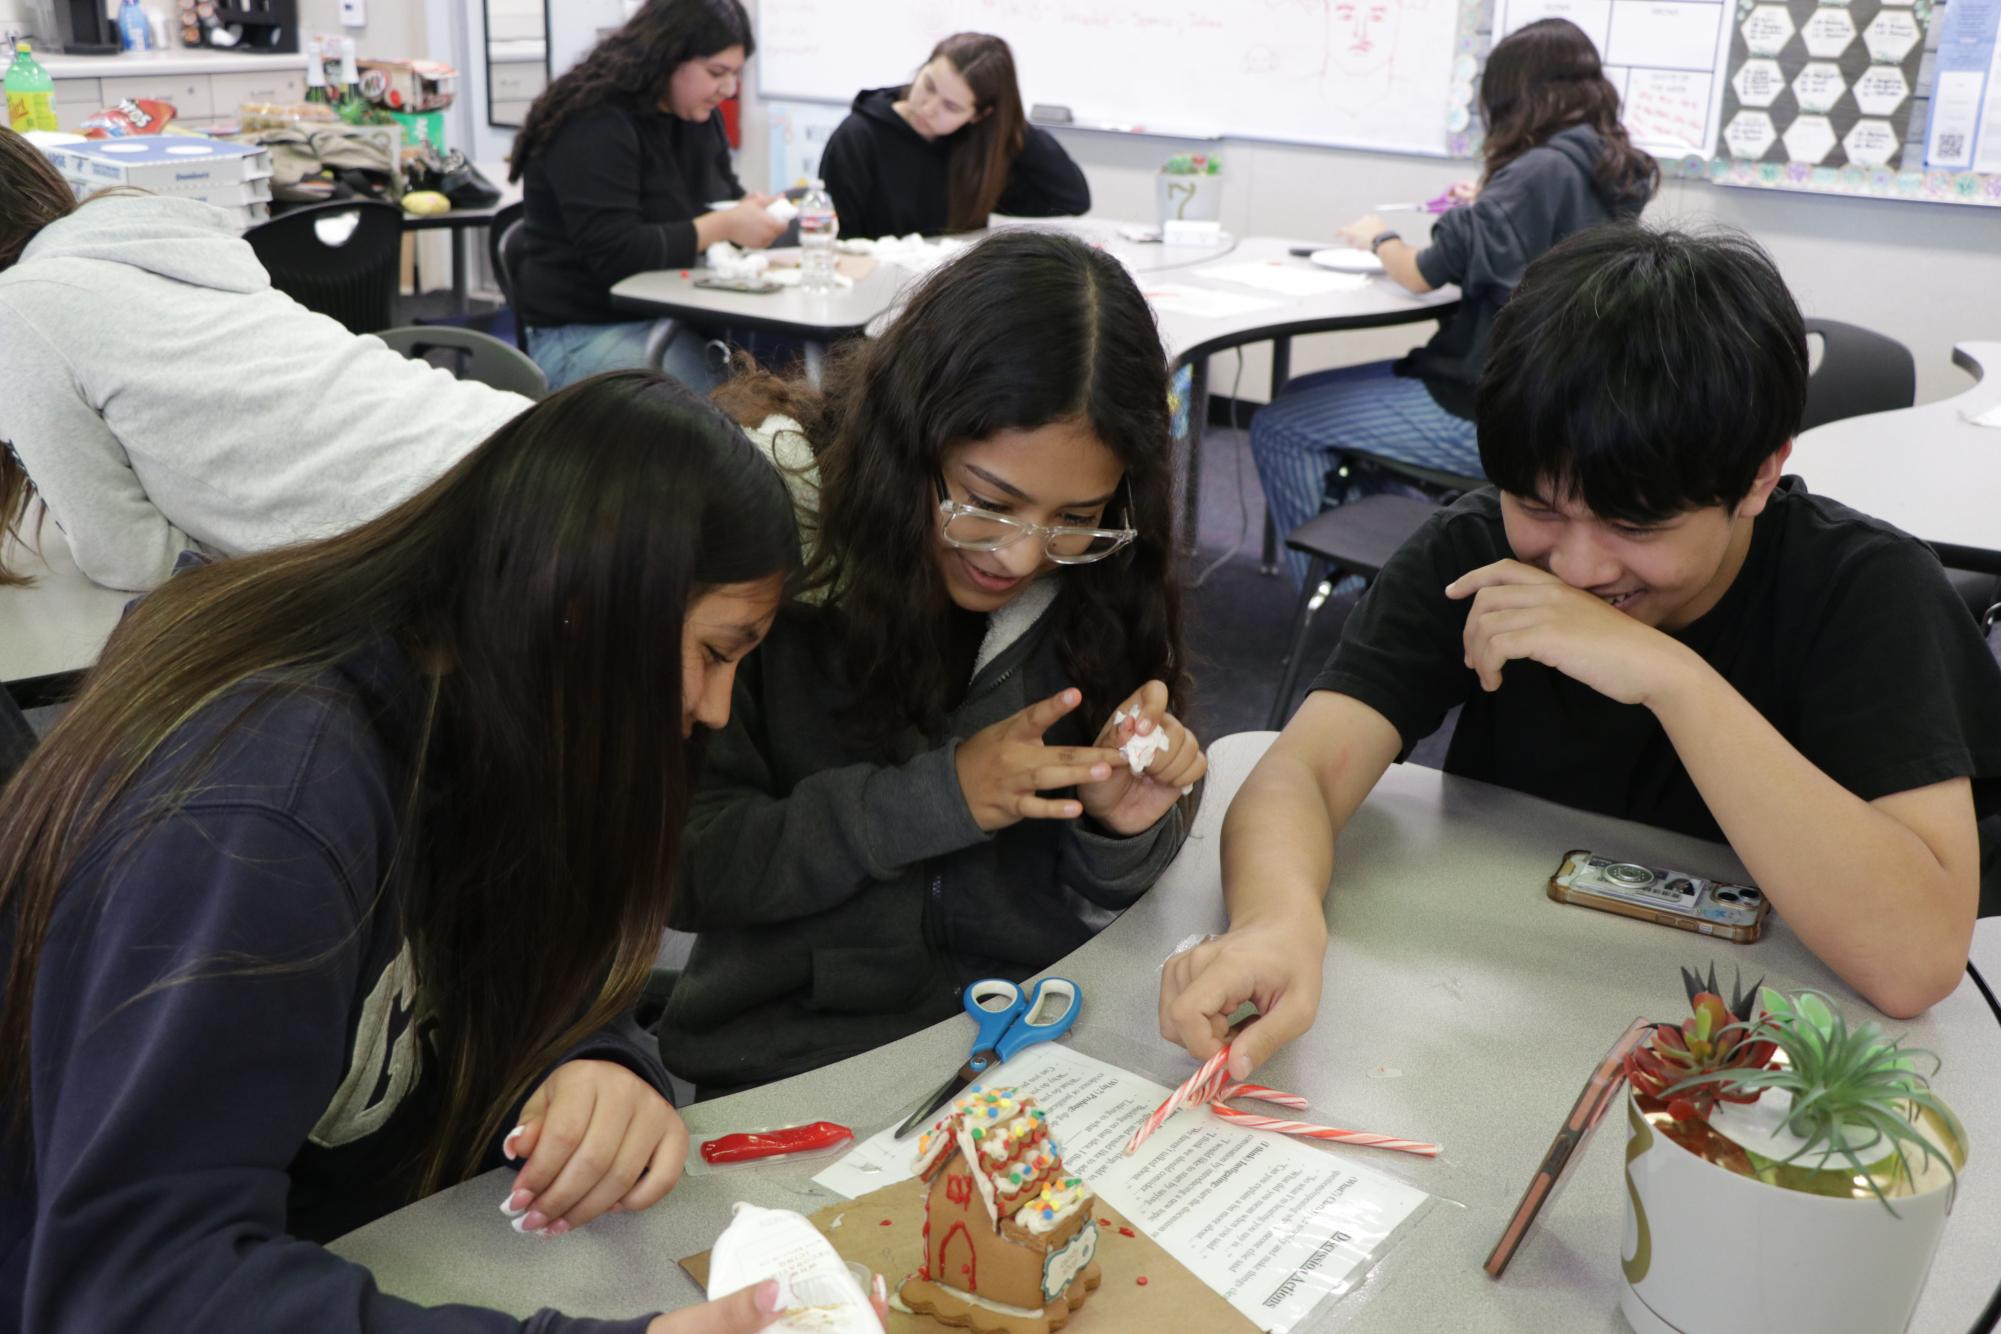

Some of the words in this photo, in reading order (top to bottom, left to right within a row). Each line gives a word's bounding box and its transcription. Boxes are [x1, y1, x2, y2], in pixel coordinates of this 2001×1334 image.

[1167, 182, 1197, 220] 7
[1077, 1071, 1105, 1091] evidence
[1065, 1092, 1098, 1114] Probing:
[1083, 1119, 1102, 1132] what
[1096, 1127, 1113, 1139] that
[1103, 1133, 1128, 1151] would
[1191, 1135, 1211, 1149] think
[1218, 1133, 1254, 1163] conversation
[1092, 1148, 1109, 1159] like
[1202, 1142, 1225, 1158] would
[1147, 1150, 1171, 1168] talked
[1163, 1154, 1188, 1173] should
[1191, 1156, 1208, 1168] like
[1093, 1164, 1110, 1175] add
[1172, 1170, 1189, 1183] start
[1176, 1166, 1216, 1197] introducing
[1256, 1172, 1273, 1184] you
[1236, 1181, 1264, 1202] explain
[1271, 1181, 1287, 1192] did
[1289, 1181, 1308, 1196] what
[1258, 1189, 1275, 1201] you
[1162, 1197, 1178, 1209] new
[1157, 1205, 1192, 1234] discussion
[1229, 1212, 1251, 1229] when
[1256, 1202, 1284, 1224] hearing
[1215, 1225, 1233, 1238] you
[1244, 1220, 1262, 1233] you
[1263, 1273, 1306, 1311] Actions
